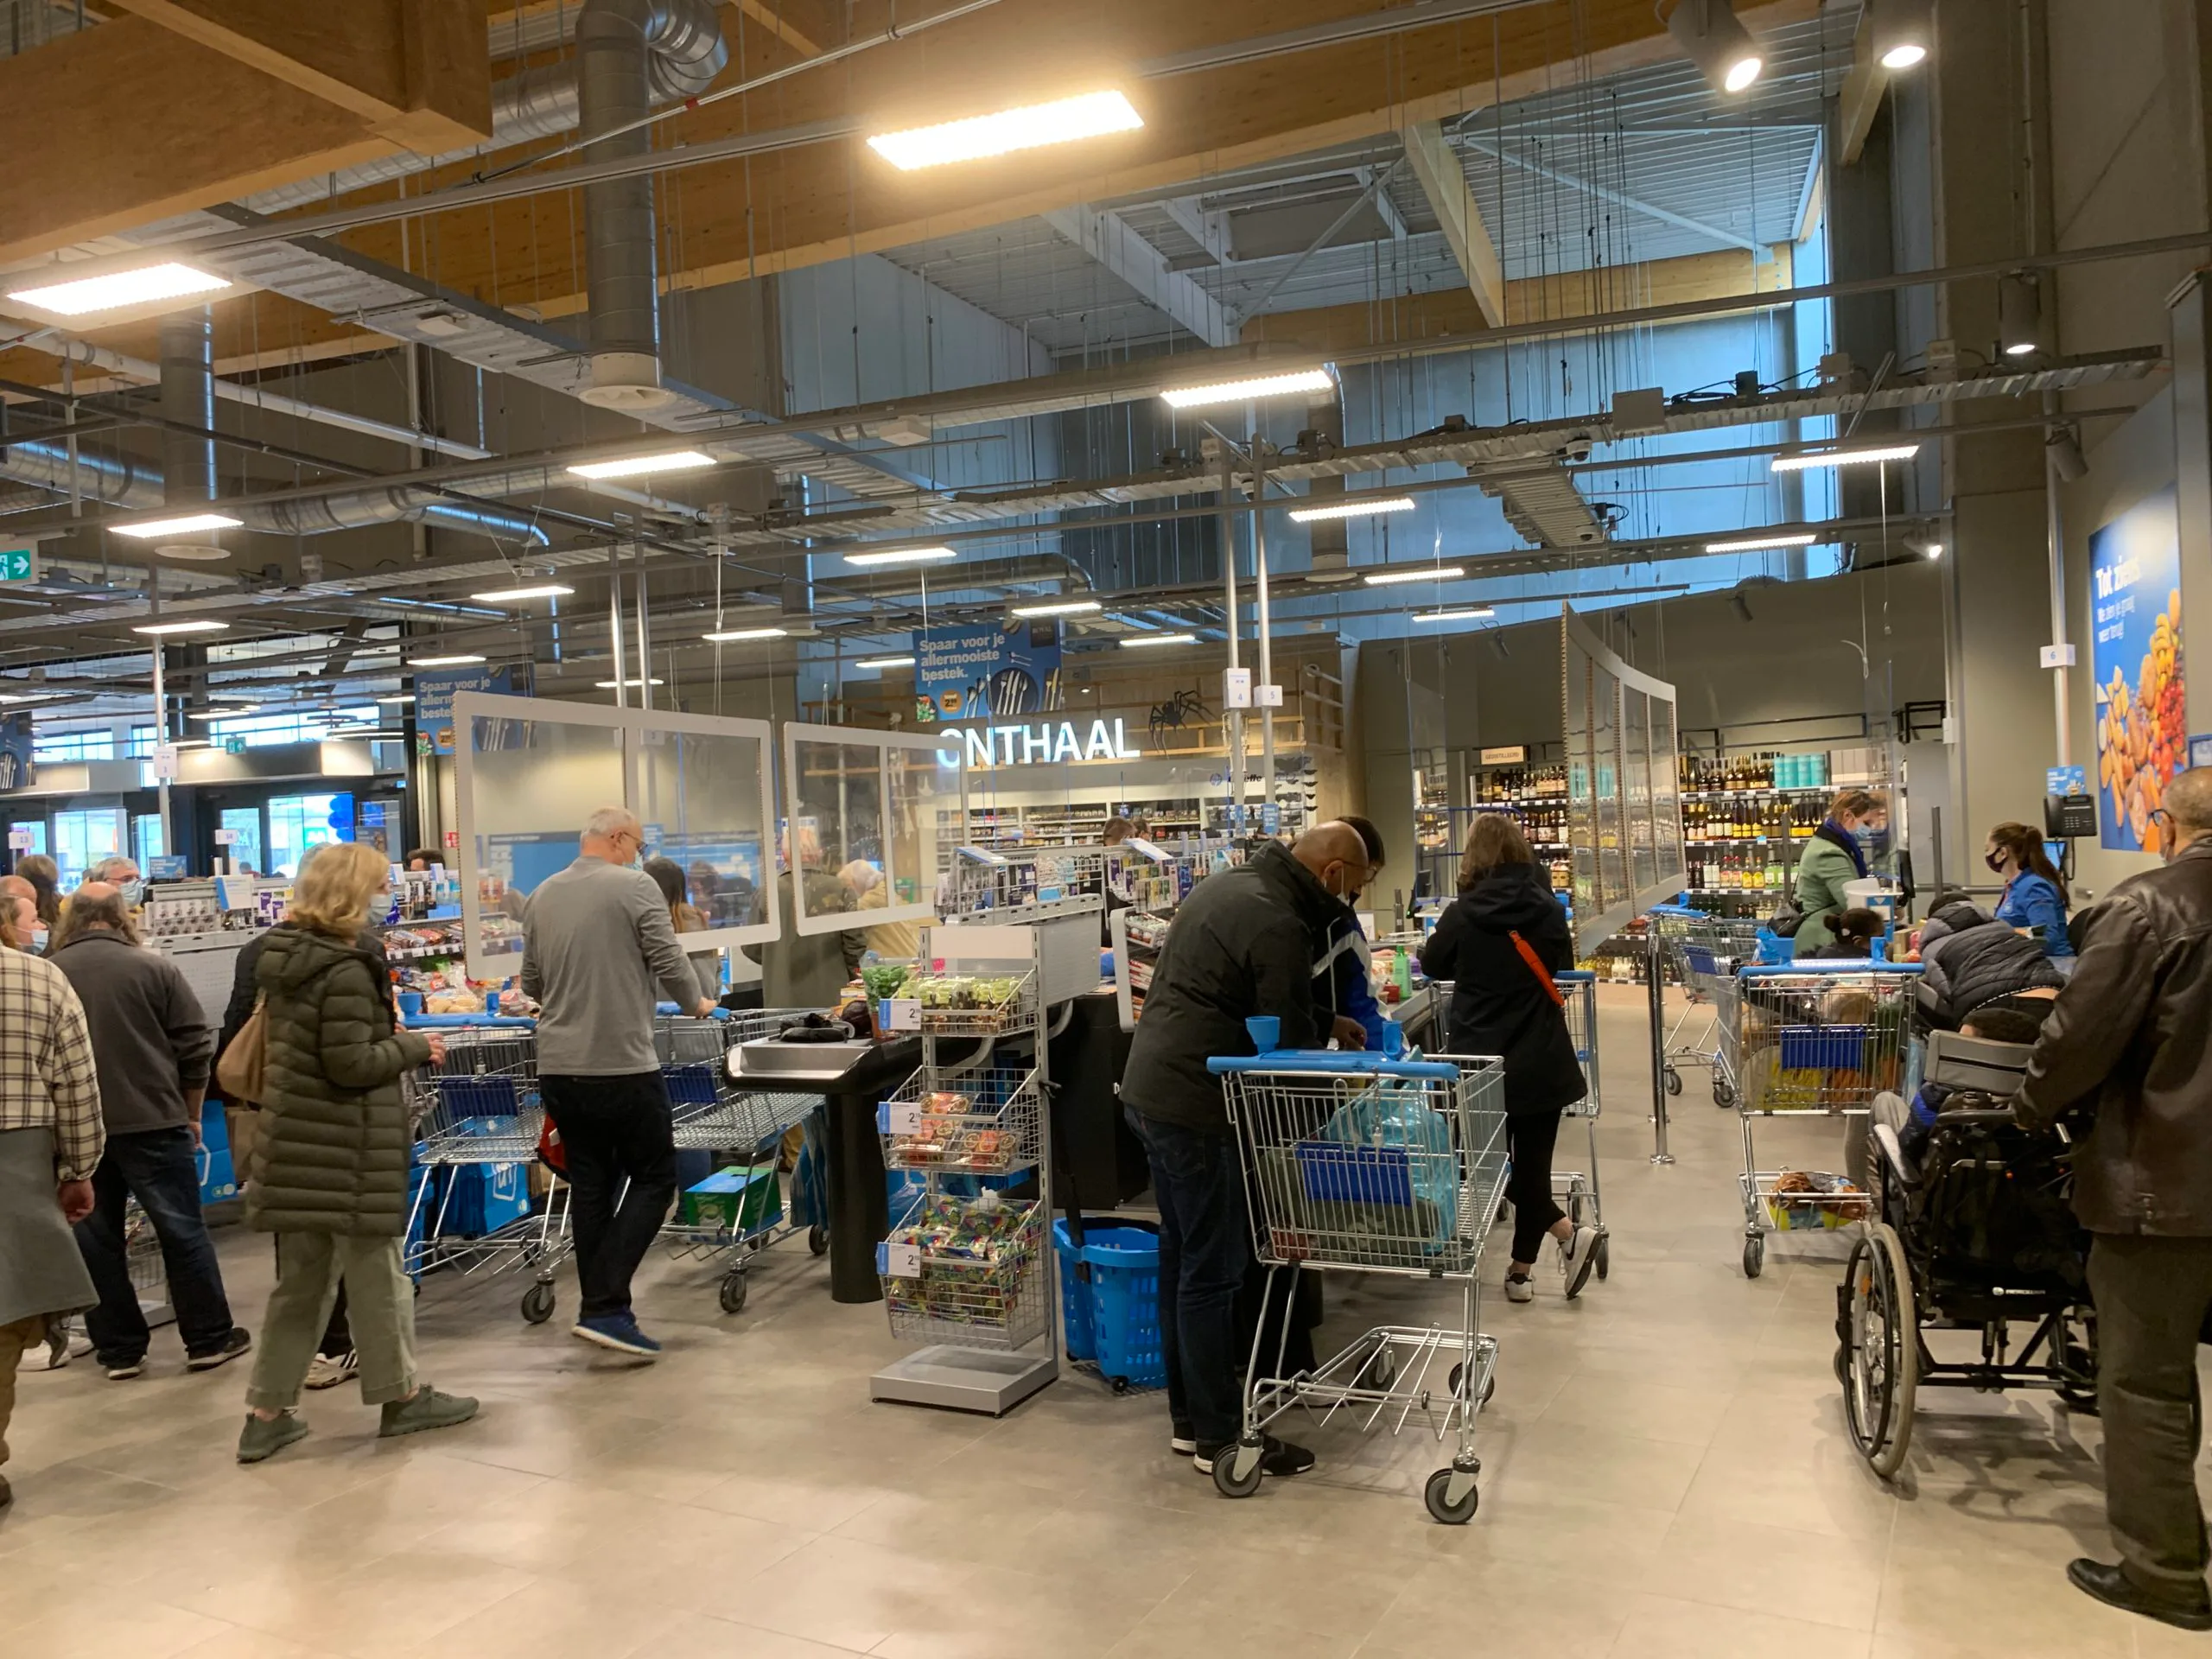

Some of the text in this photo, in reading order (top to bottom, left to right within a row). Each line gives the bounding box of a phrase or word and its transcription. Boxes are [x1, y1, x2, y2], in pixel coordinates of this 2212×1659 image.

[919, 632, 1005, 654] Spaar voor je
[921, 649, 1000, 666] allermooiste
[921, 666, 969, 681] bestek.
[420, 676, 491, 693] Spaar voor je
